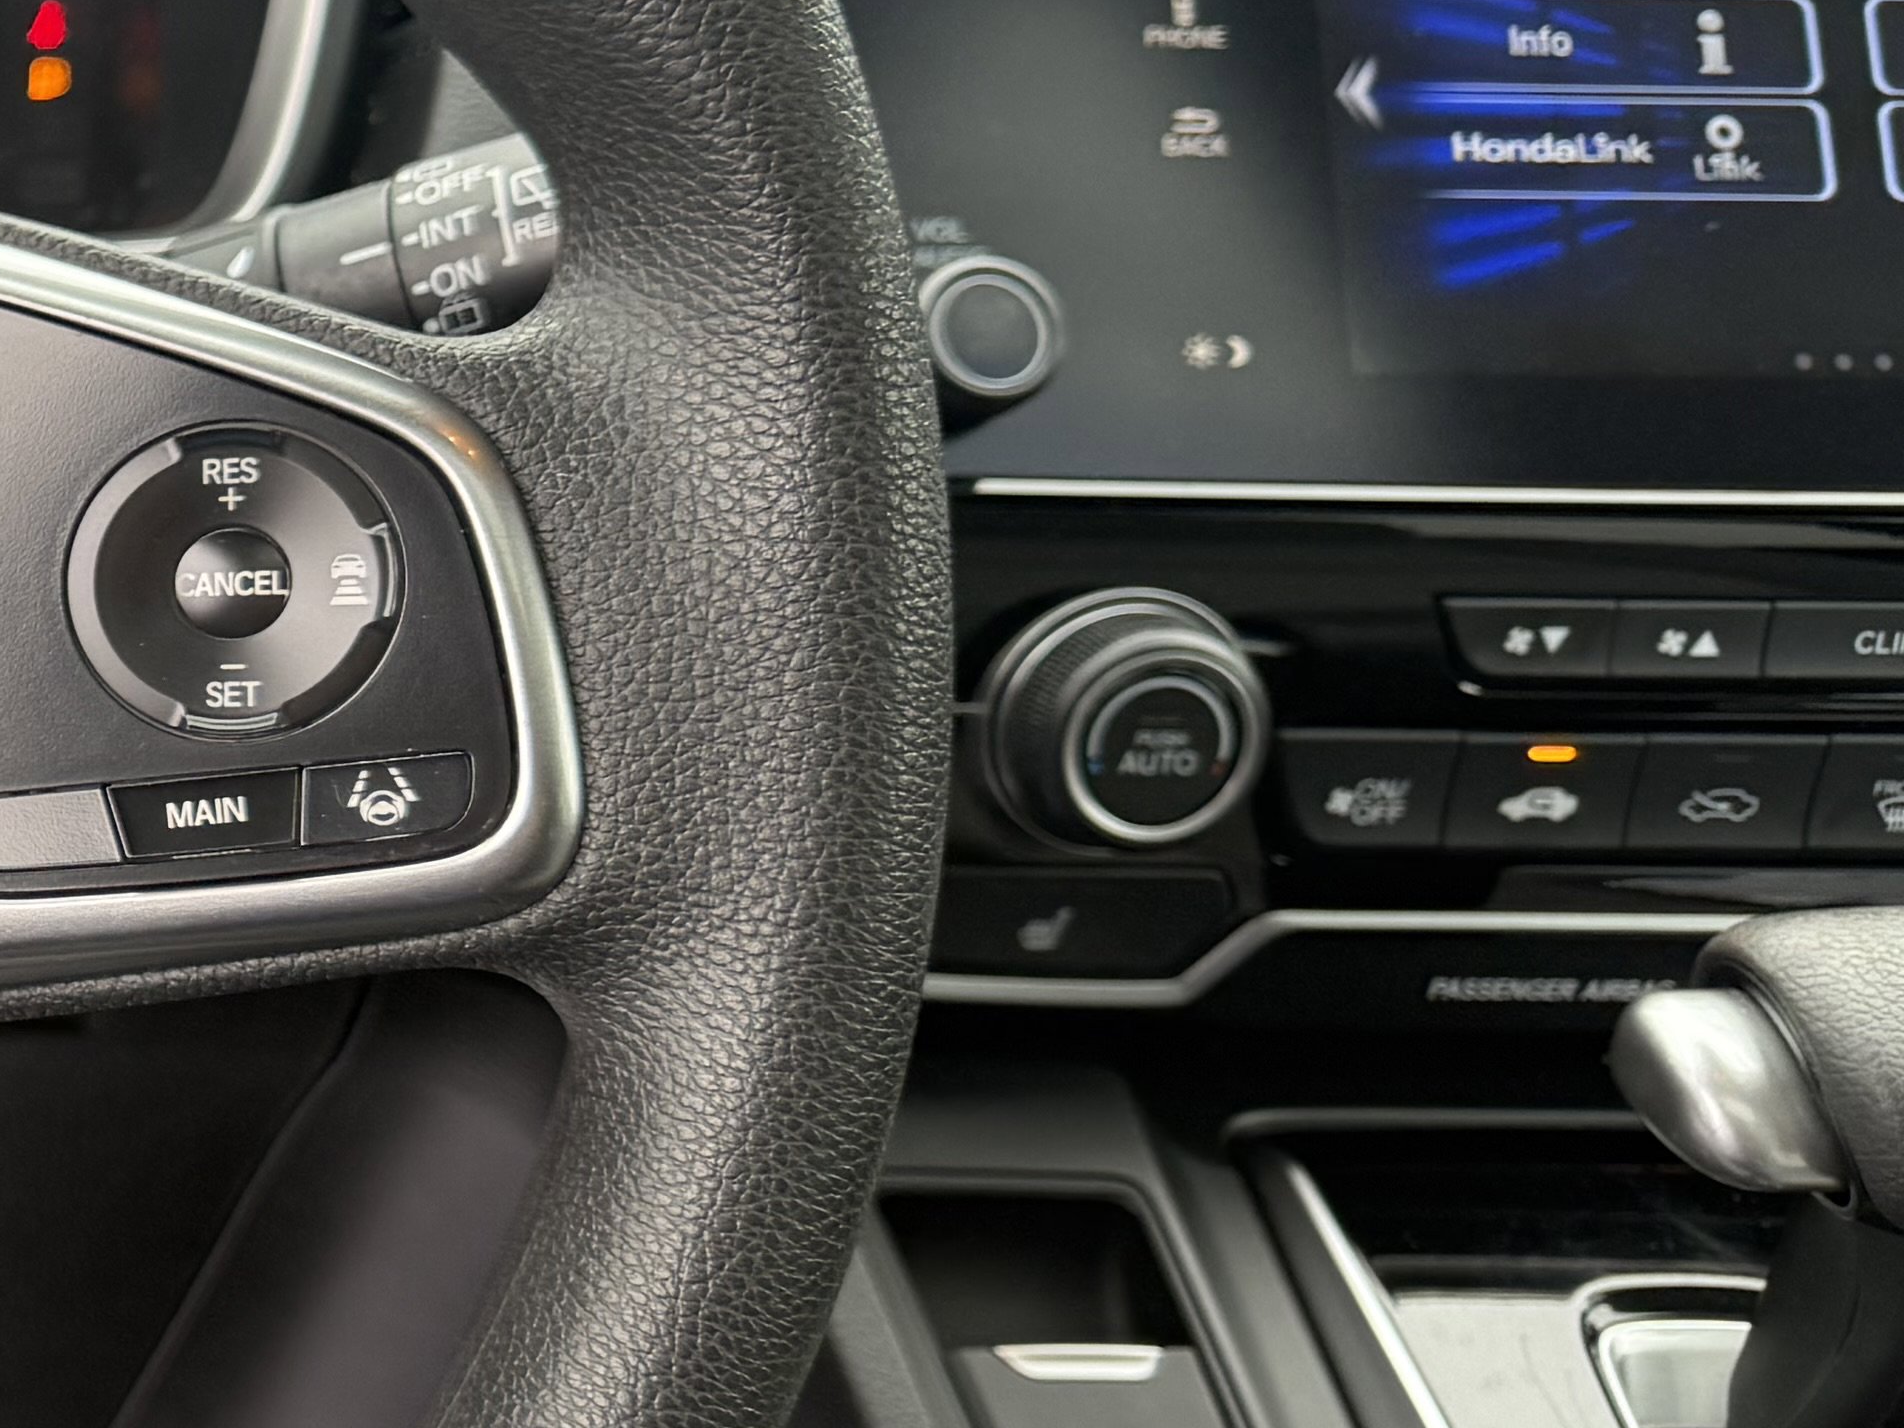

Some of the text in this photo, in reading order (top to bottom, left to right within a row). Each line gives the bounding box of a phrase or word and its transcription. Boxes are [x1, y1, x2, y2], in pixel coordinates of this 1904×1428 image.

[1142, 24, 1230, 50] PHONE
[1507, 23, 1574, 58] Info
[1450, 130, 1654, 164] HondaLink
[414, 163, 493, 206] OFF
[418, 204, 487, 250] INT
[512, 210, 561, 244] RE
[430, 254, 492, 297] ON
[201, 456, 261, 486] RES
[177, 570, 290, 598] CANCEL
[204, 679, 263, 708] SET
[1116, 749, 1199, 777] AUTO
[164, 794, 250, 830] MAIN
[1426, 975, 1581, 1003] PASSENGER
